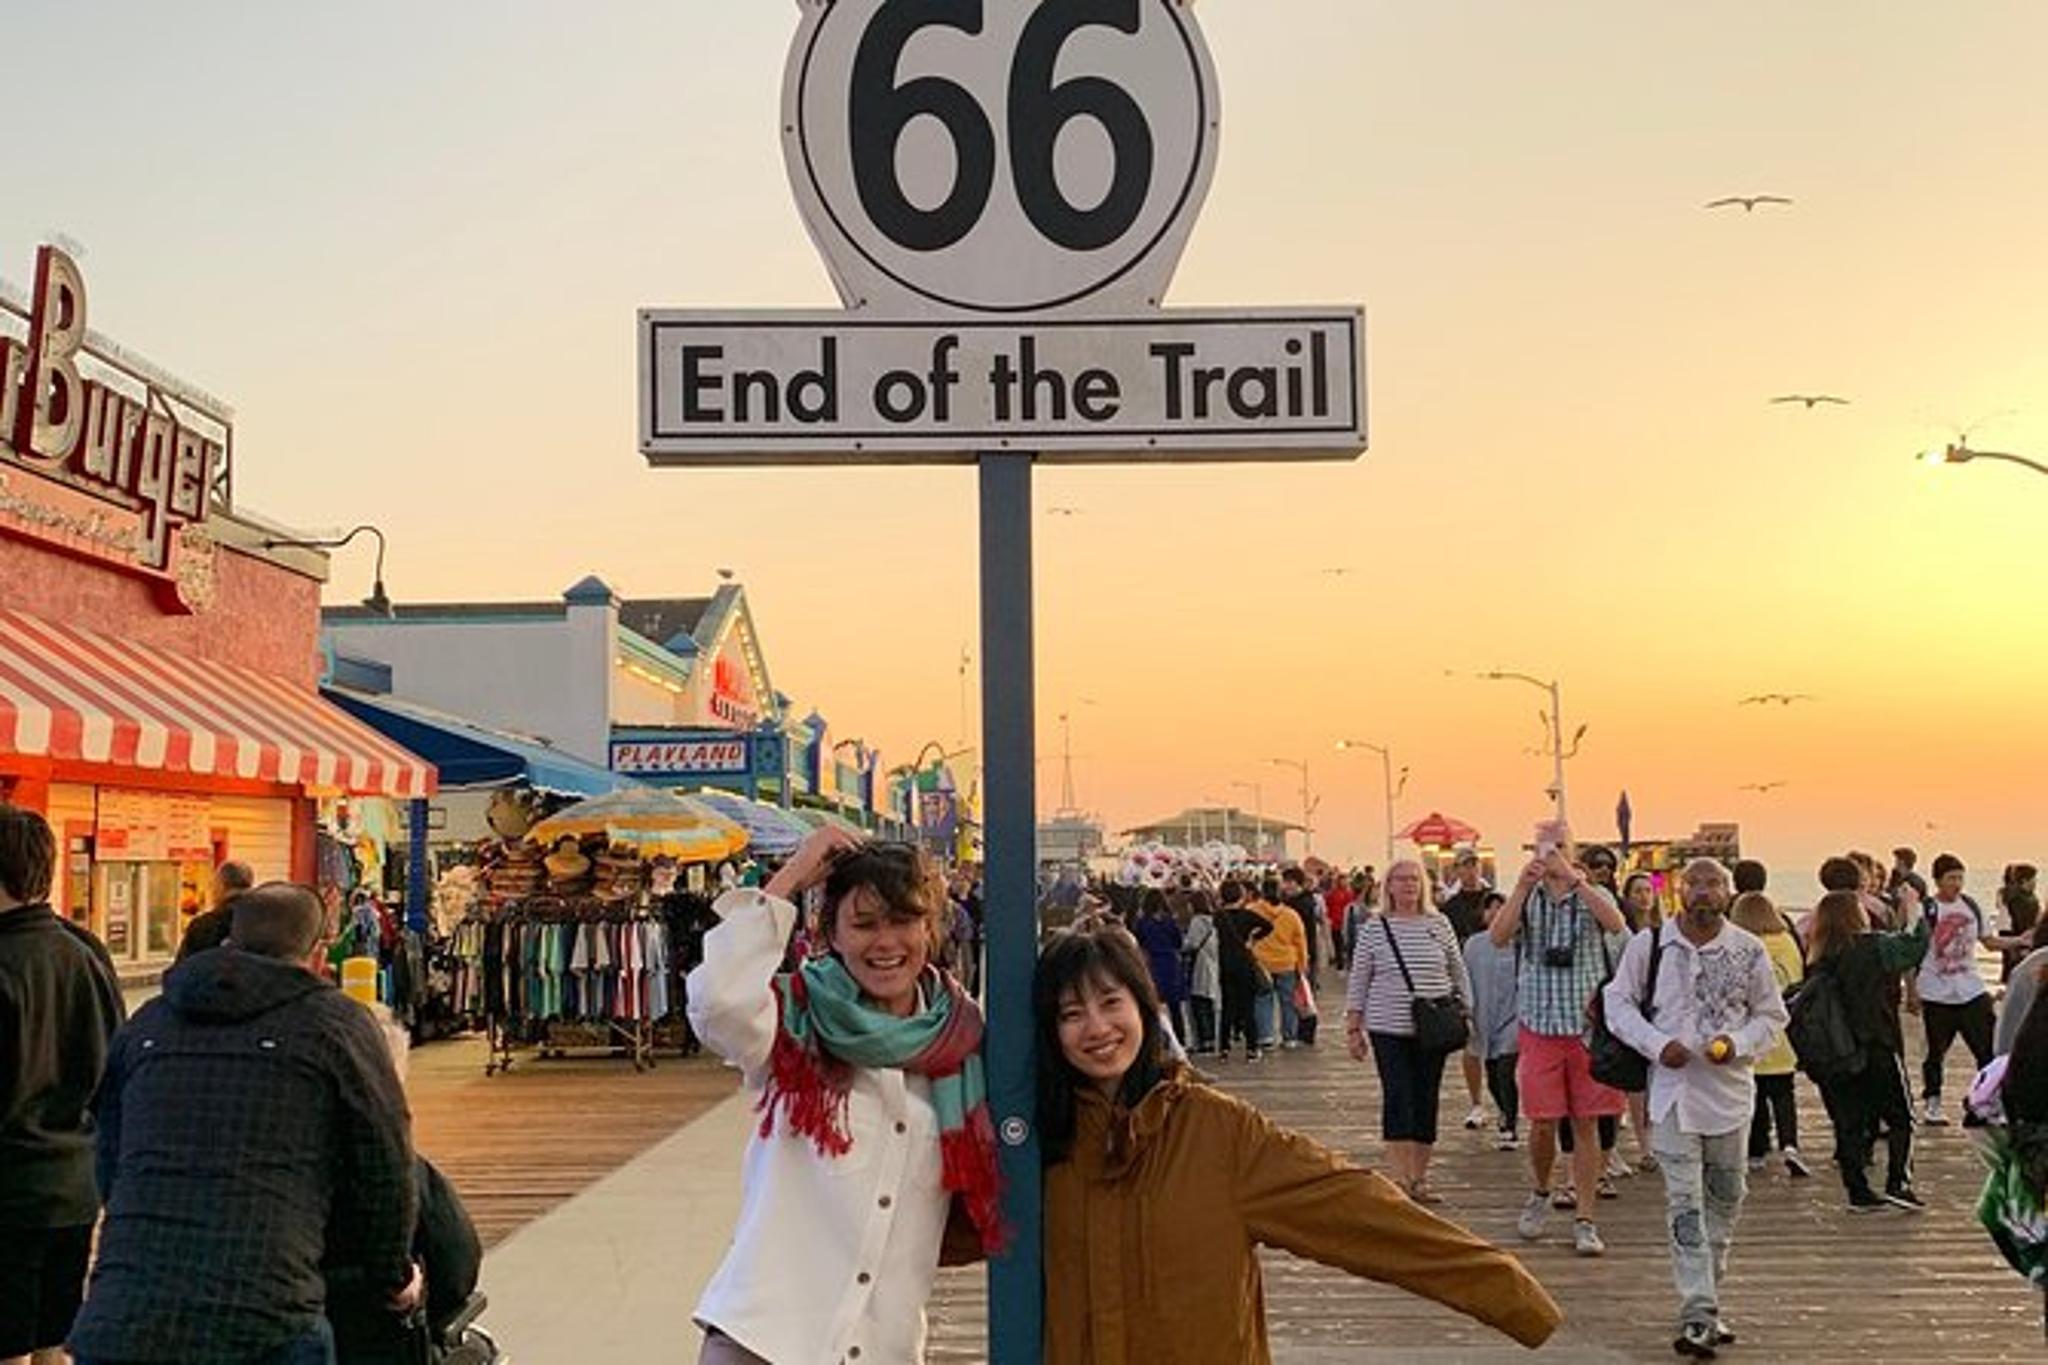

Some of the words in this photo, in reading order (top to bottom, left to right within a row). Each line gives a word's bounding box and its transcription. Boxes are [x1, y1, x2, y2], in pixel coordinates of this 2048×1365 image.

[848, 0, 1154, 252] 66
[27, 244, 224, 569] Burger
[681, 335, 839, 424] End
[872, 334, 960, 424] of
[988, 335, 1121, 423] the
[1148, 330, 1329, 420] Trail
[617, 744, 741, 763] PLAYLAND
